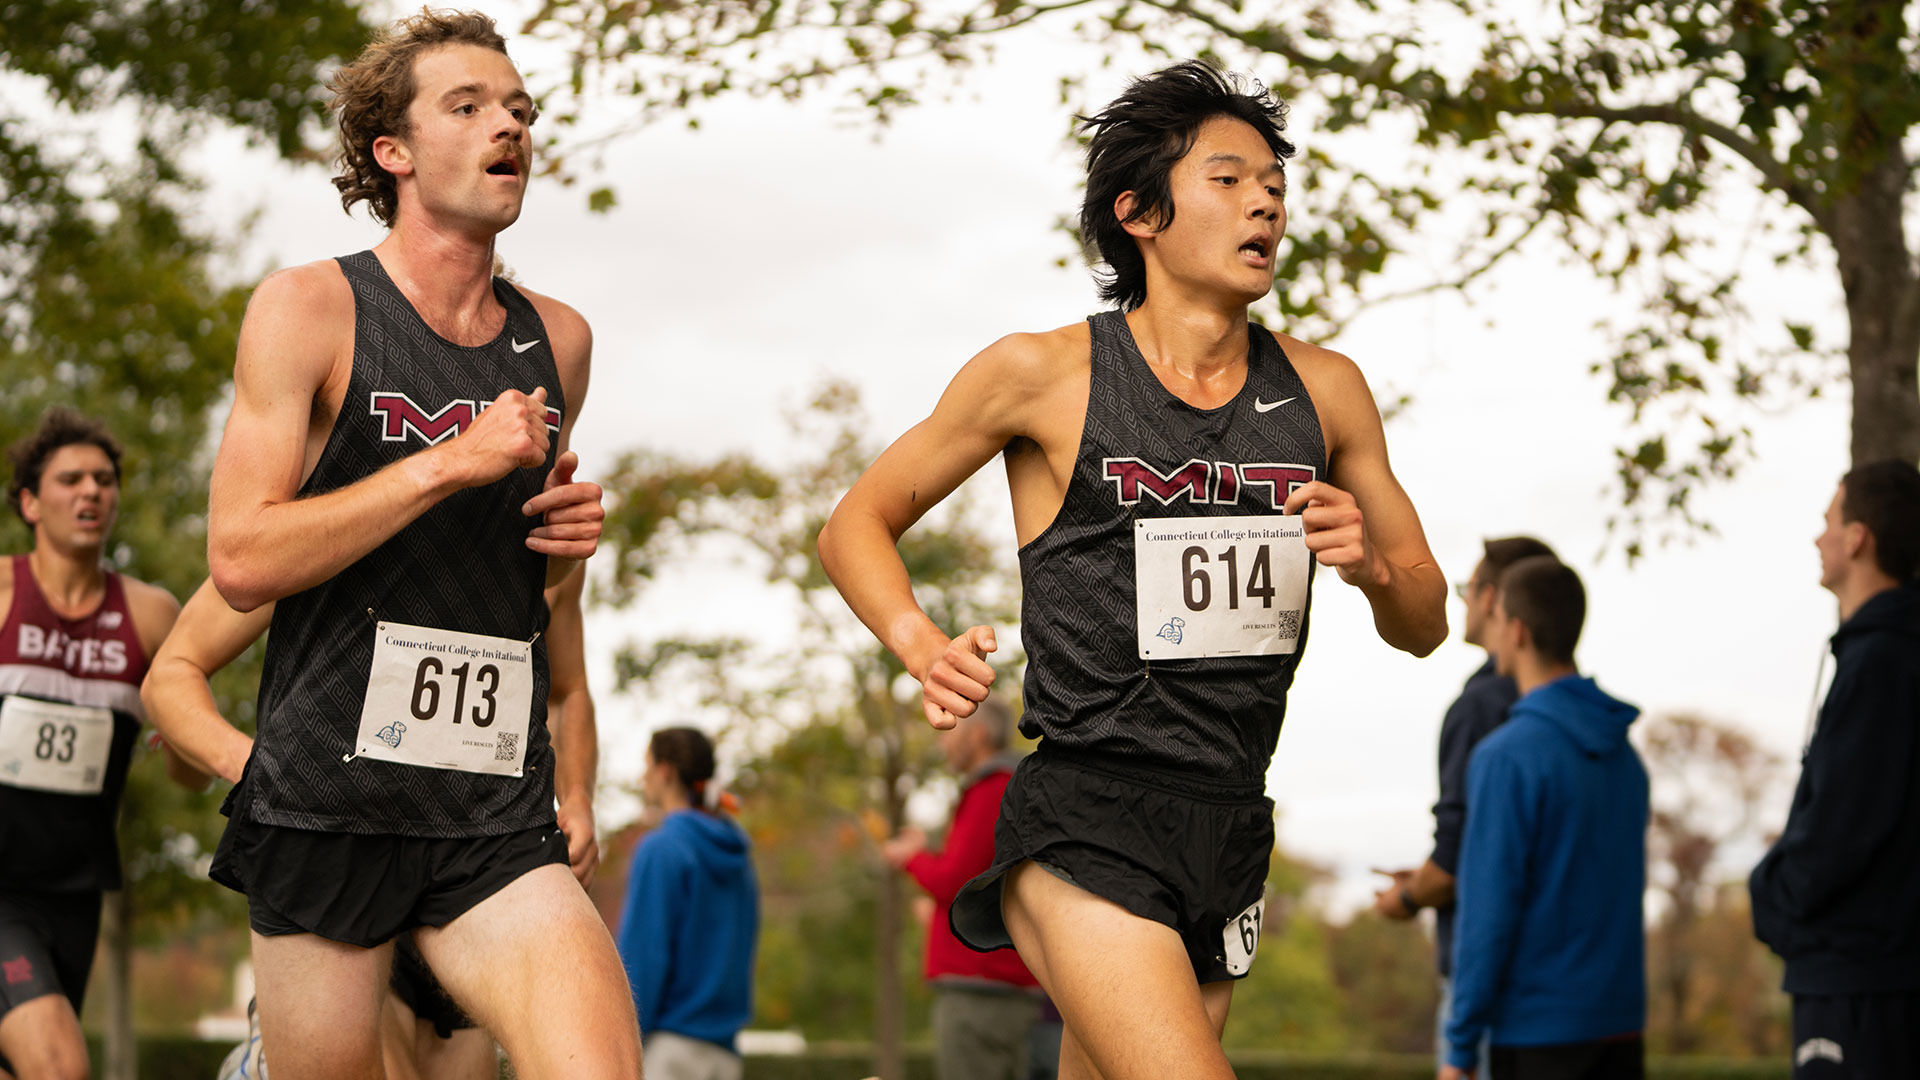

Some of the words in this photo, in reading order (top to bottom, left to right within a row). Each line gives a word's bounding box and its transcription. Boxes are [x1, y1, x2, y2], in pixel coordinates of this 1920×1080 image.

[1103, 457, 1316, 510] MIT
[1146, 531, 1208, 542] Connecticut
[1210, 529, 1246, 541] College
[1248, 528, 1303, 539] Invitational
[1181, 544, 1276, 612] 614
[18, 623, 127, 674] BATES
[386, 636, 446, 653] Connecticut
[448, 644, 481, 658] College
[482, 650, 527, 663] Invitational
[410, 656, 500, 727] 613
[36, 722, 77, 763] 83
